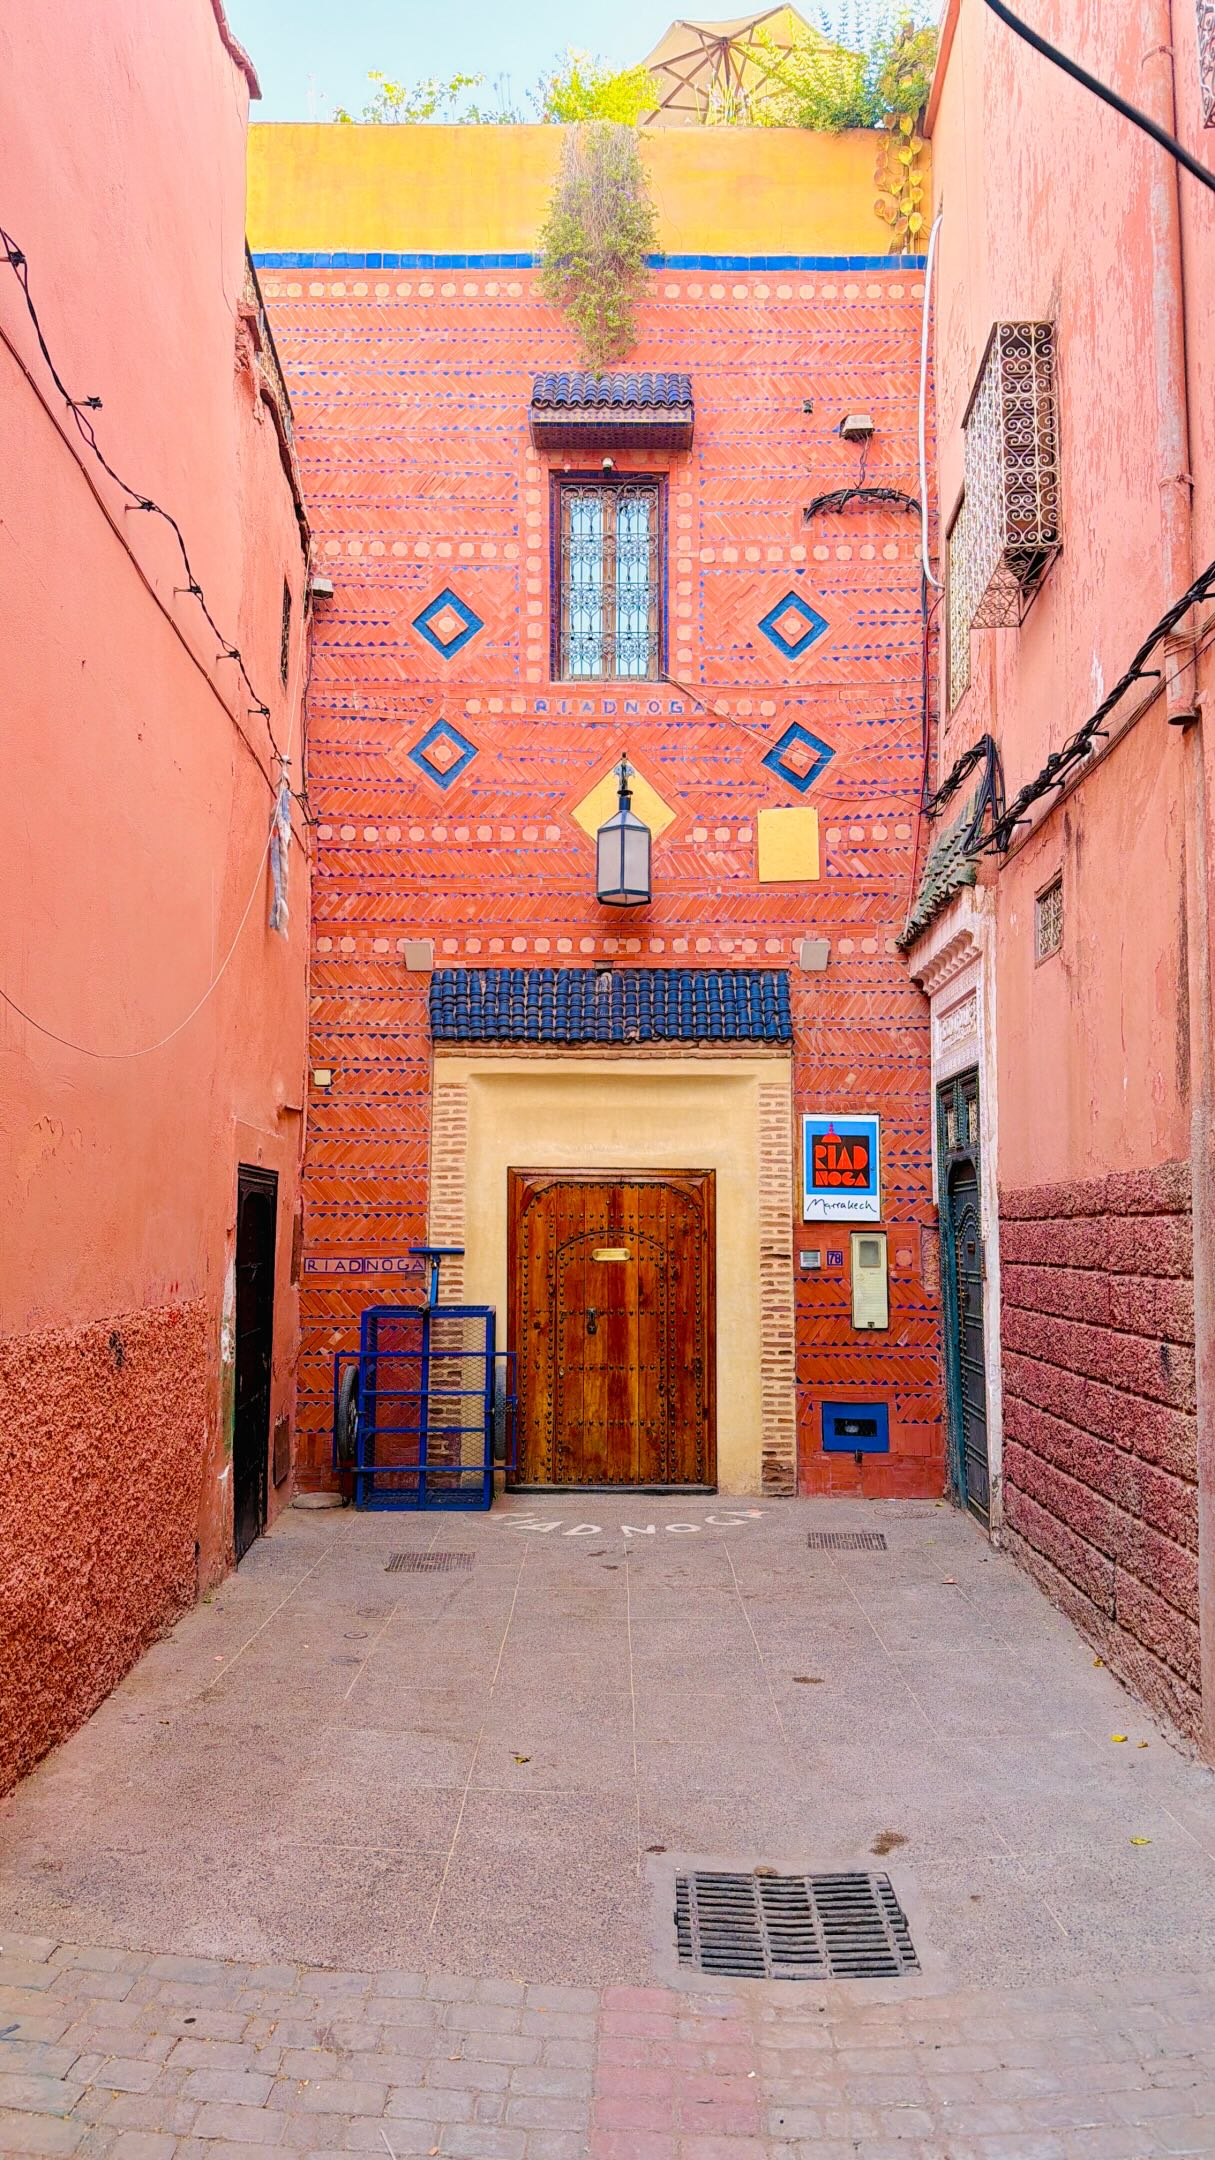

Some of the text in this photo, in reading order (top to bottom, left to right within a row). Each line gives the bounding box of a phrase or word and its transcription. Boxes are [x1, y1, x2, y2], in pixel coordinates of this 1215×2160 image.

[815, 1145, 868, 1170] RIAD
[815, 1171, 868, 1186] NOGA
[807, 1198, 877, 1215] Marrakech
[307, 1260, 424, 1273] RIAD NOGA
[828, 1253, 841, 1266] 78
[620, 1510, 769, 1538] NOGA
